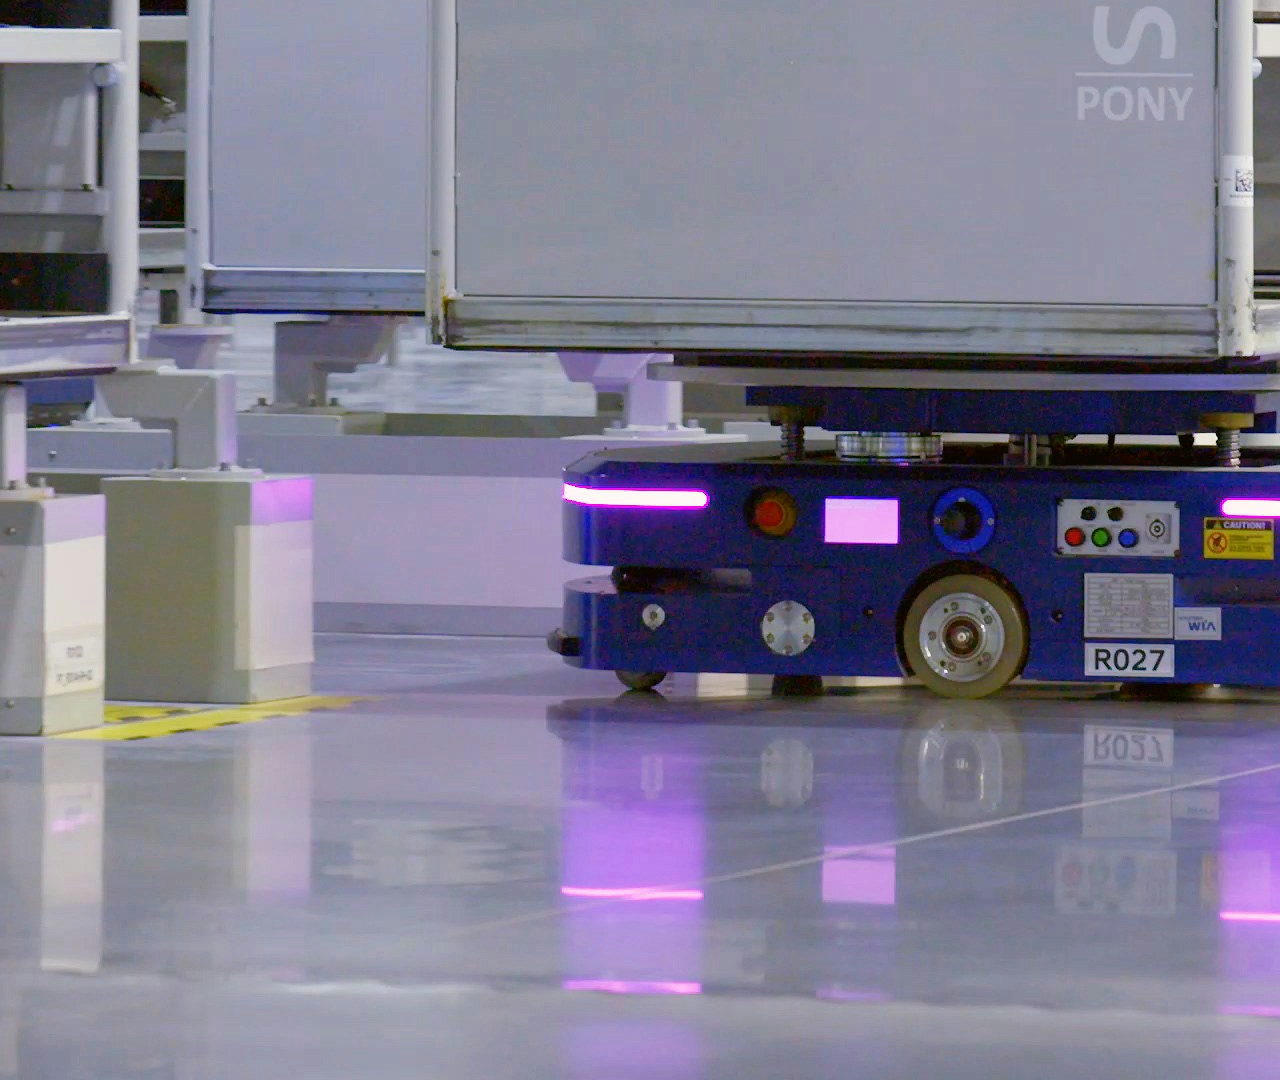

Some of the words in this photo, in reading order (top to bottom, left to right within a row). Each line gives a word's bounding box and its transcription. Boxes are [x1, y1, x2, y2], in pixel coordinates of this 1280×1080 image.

[1077, 86, 1193, 122] PONY
[1223, 521, 1266, 530] CAUTION!
[1094, 648, 1165, 671] R027
